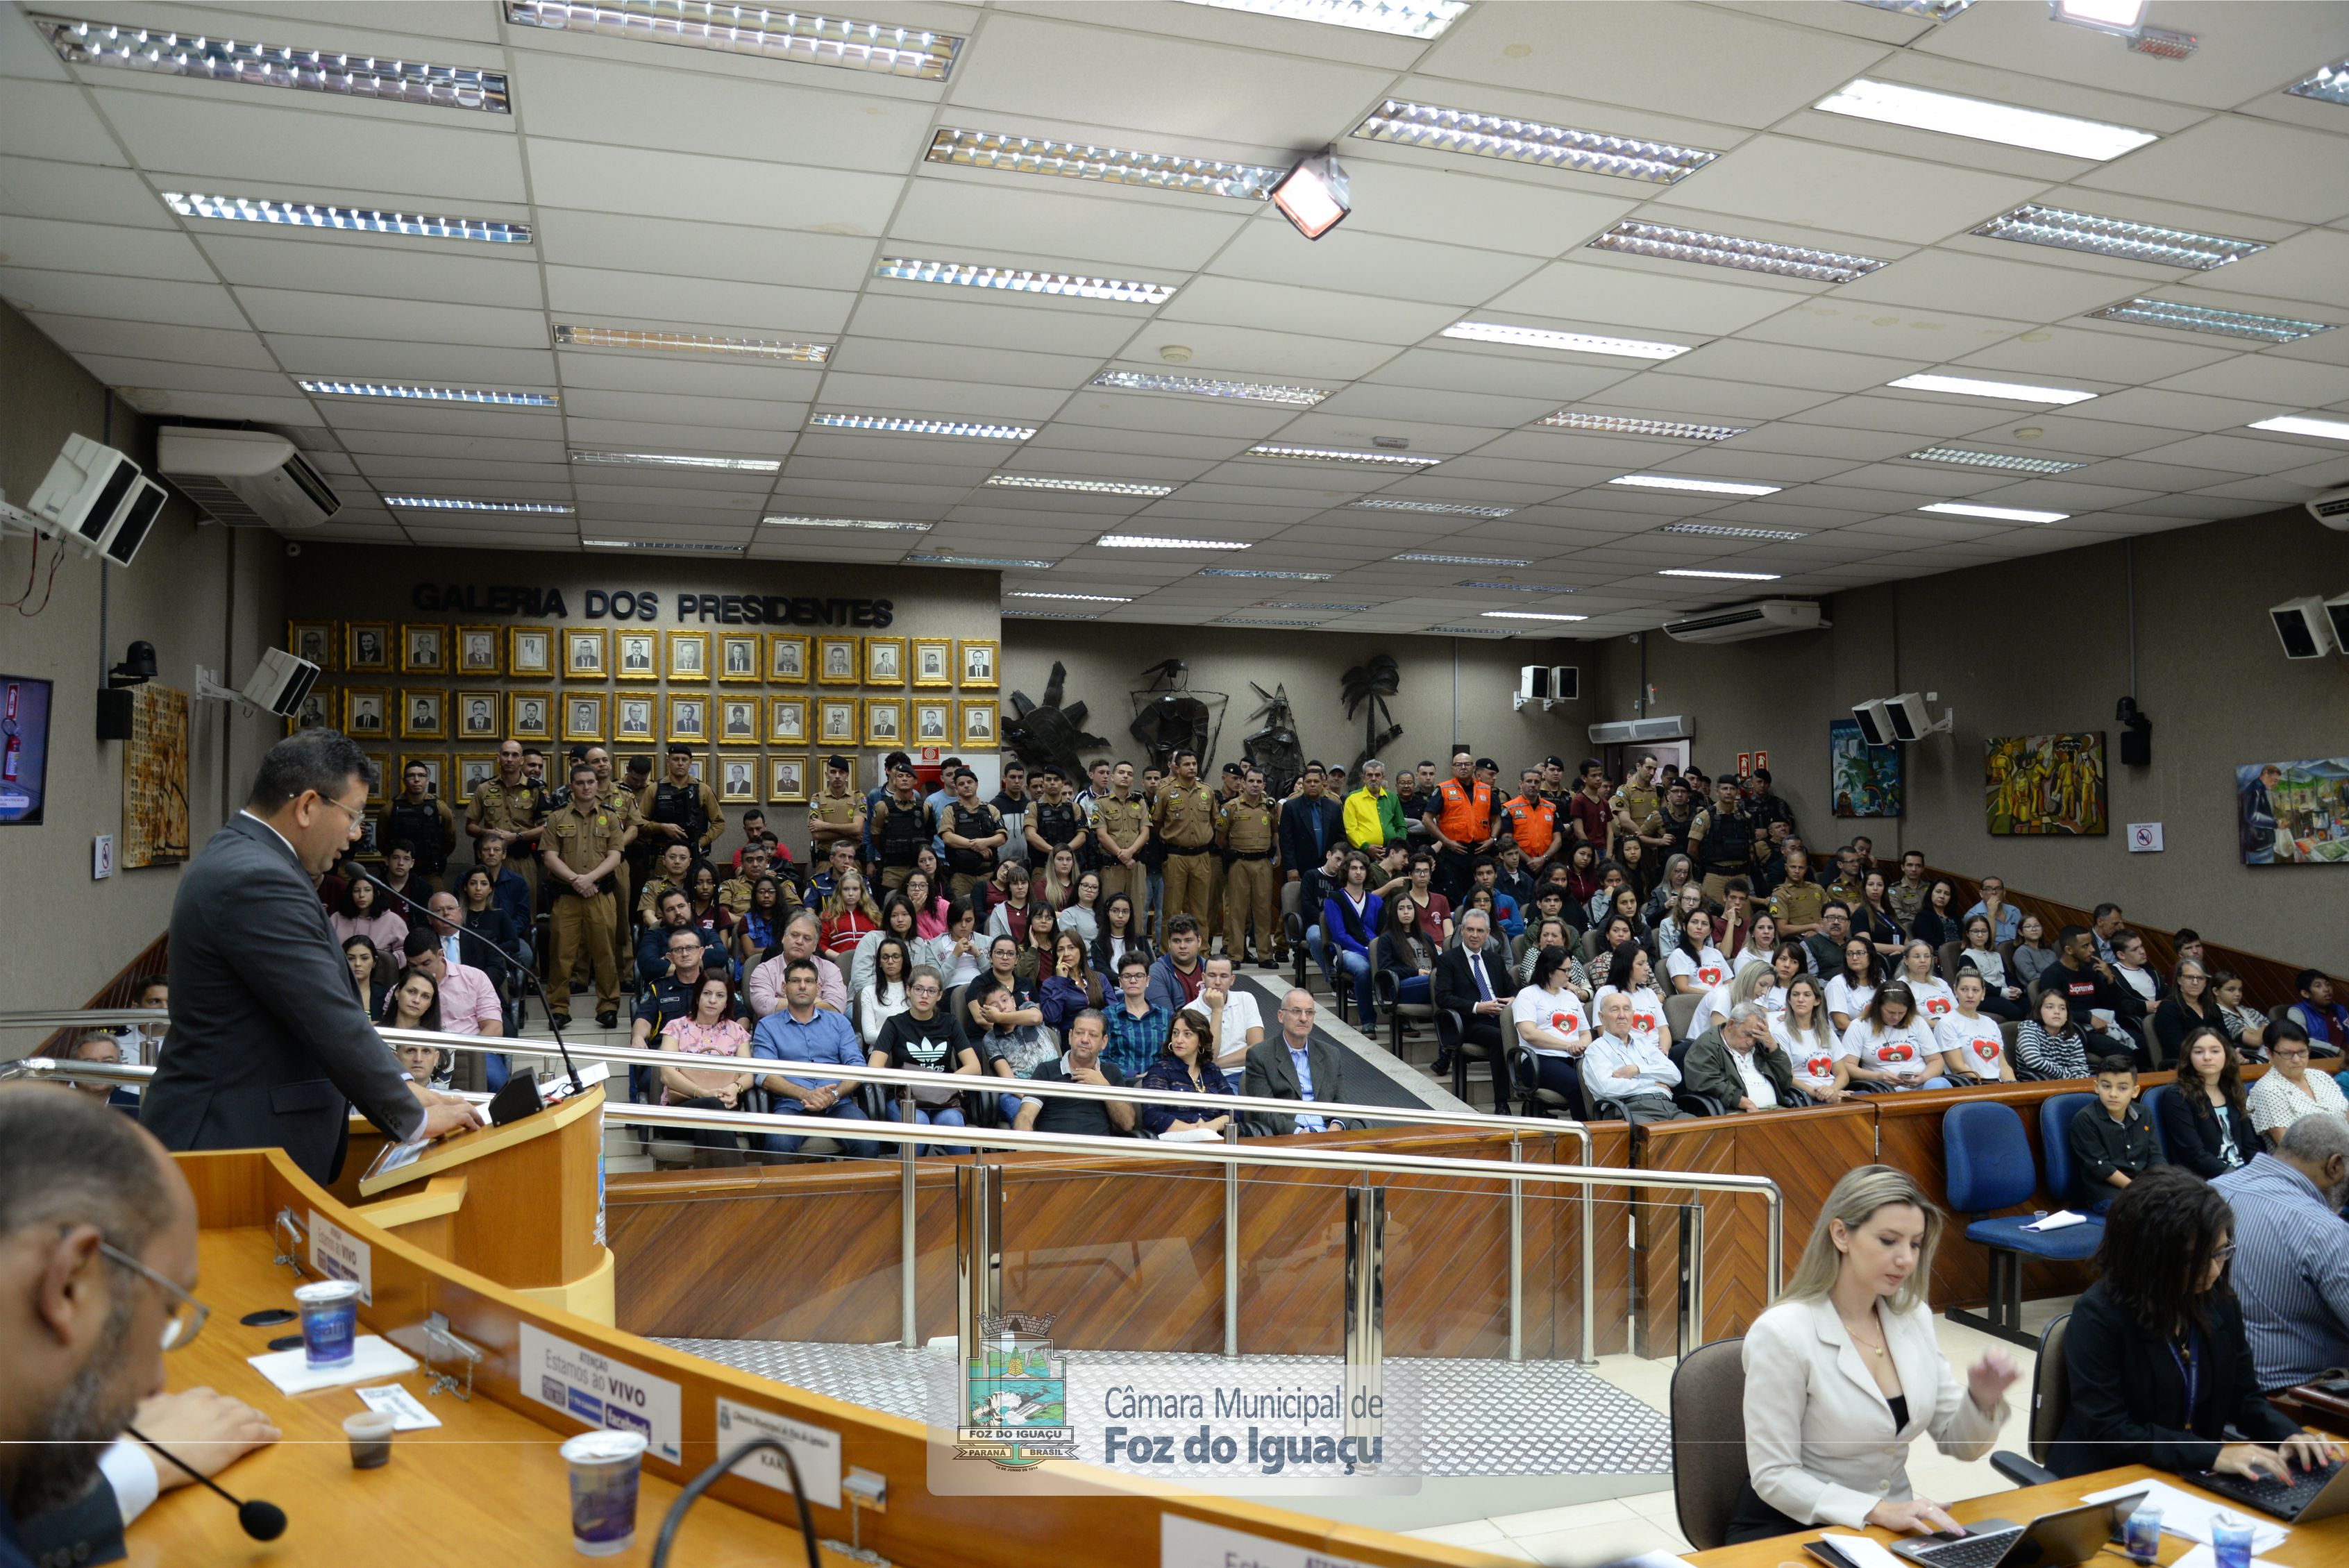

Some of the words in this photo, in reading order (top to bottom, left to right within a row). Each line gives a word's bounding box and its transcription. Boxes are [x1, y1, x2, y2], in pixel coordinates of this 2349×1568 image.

[413, 582, 567, 618] GALERIA
[586, 589, 658, 621] DOS
[677, 593, 894, 628] PRESIDENTES
[2069, 984, 2094, 994] Supreme
[342, 1244, 357, 1267] VIVO
[579, 1351, 608, 1373] ATENÇÃO
[546, 1349, 589, 1385] Estamos
[592, 1372, 605, 1391] ao
[608, 1377, 646, 1408] VIVO
